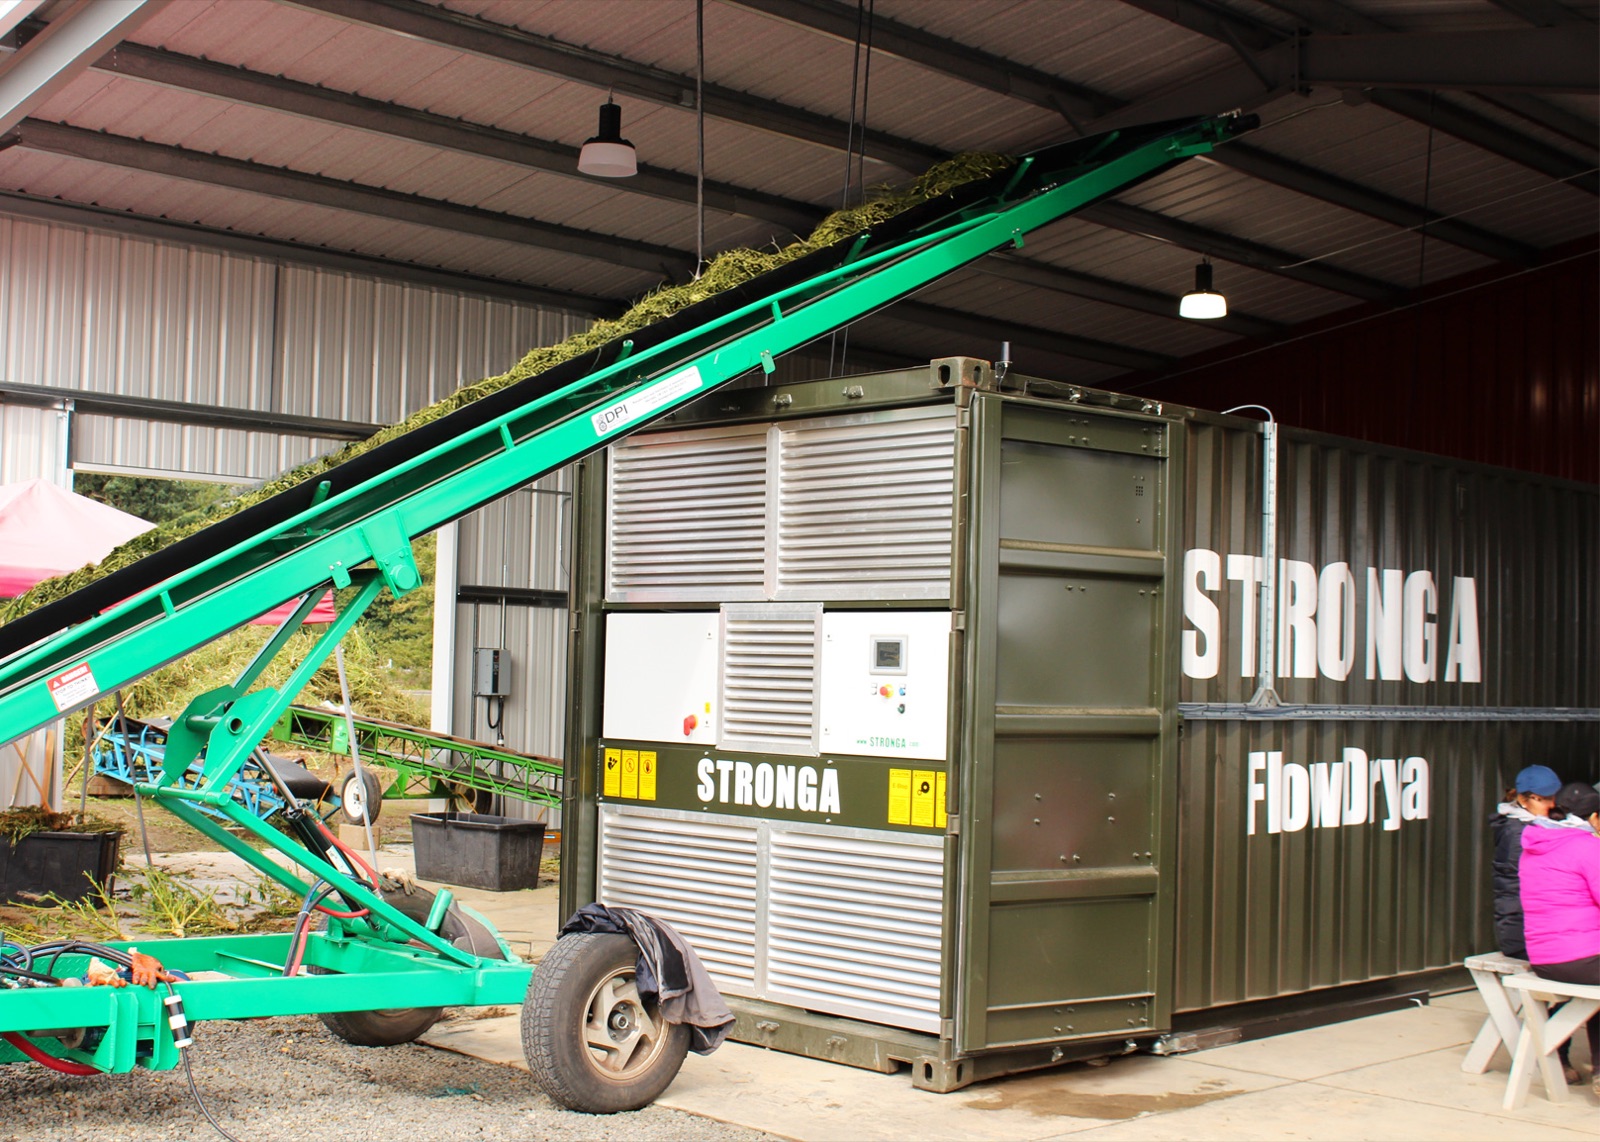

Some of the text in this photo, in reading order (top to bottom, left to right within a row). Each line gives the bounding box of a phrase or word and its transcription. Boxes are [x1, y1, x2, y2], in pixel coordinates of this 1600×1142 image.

[605, 404, 628, 423] DPI
[1182, 548, 1481, 683] STRONGA
[870, 736, 906, 748] STRONGA
[697, 758, 841, 815] STRONGA
[1247, 747, 1430, 836] FlowDrya
